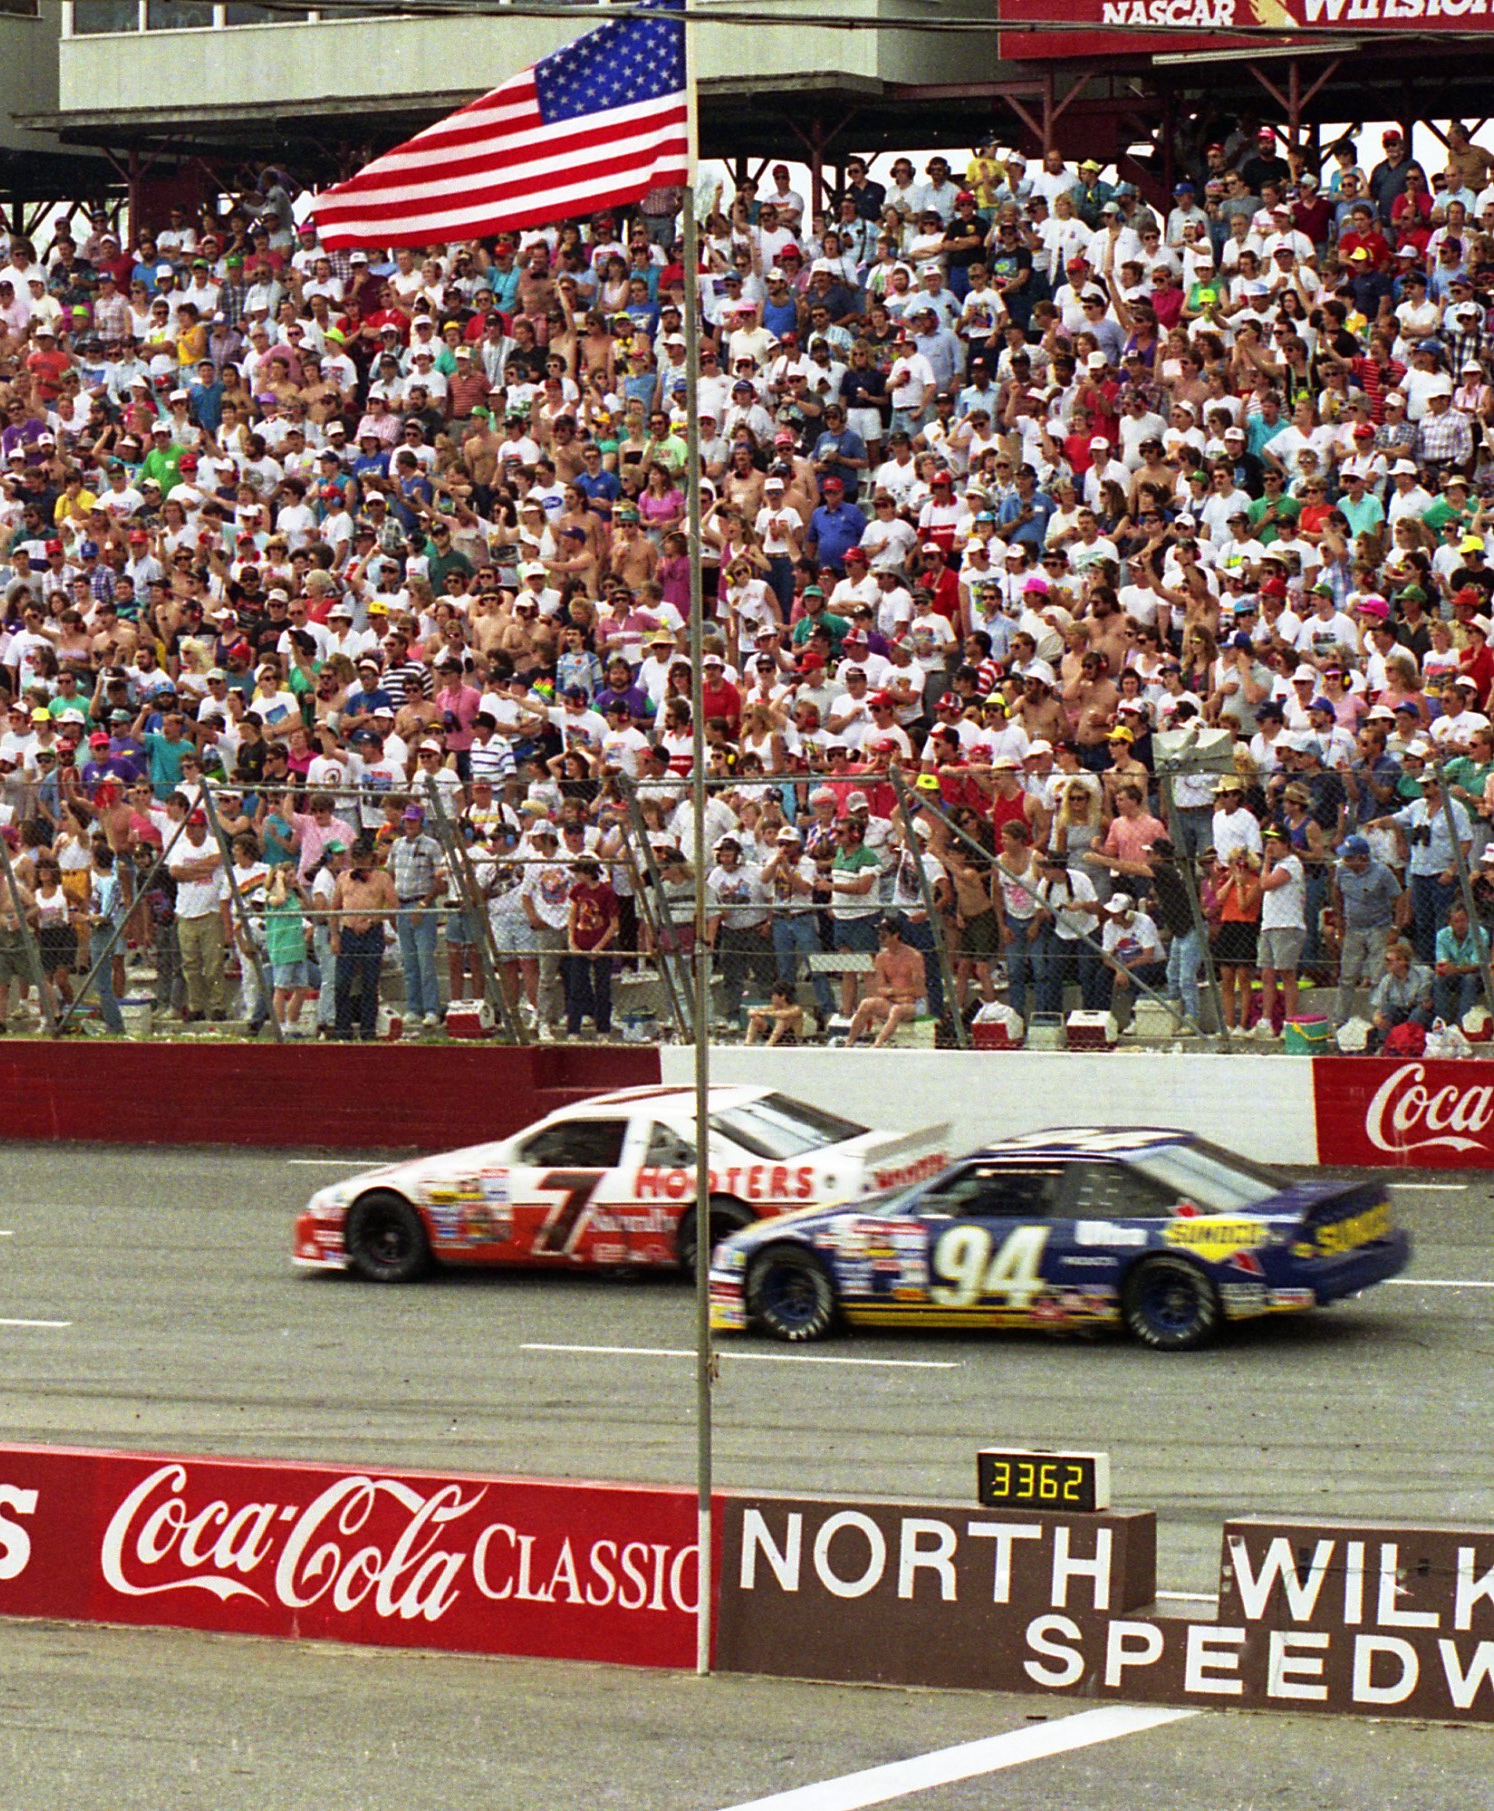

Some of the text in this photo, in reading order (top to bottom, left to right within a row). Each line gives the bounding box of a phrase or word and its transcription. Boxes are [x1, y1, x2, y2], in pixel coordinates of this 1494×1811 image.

[531, 1169, 608, 1259] 7
[927, 1224, 1053, 1308] 94
[992, 1461, 1083, 1500] 3362
[100, 1463, 700, 1622] Coca-Cola CLASSIC
[738, 1507, 1113, 1611] NORTH
